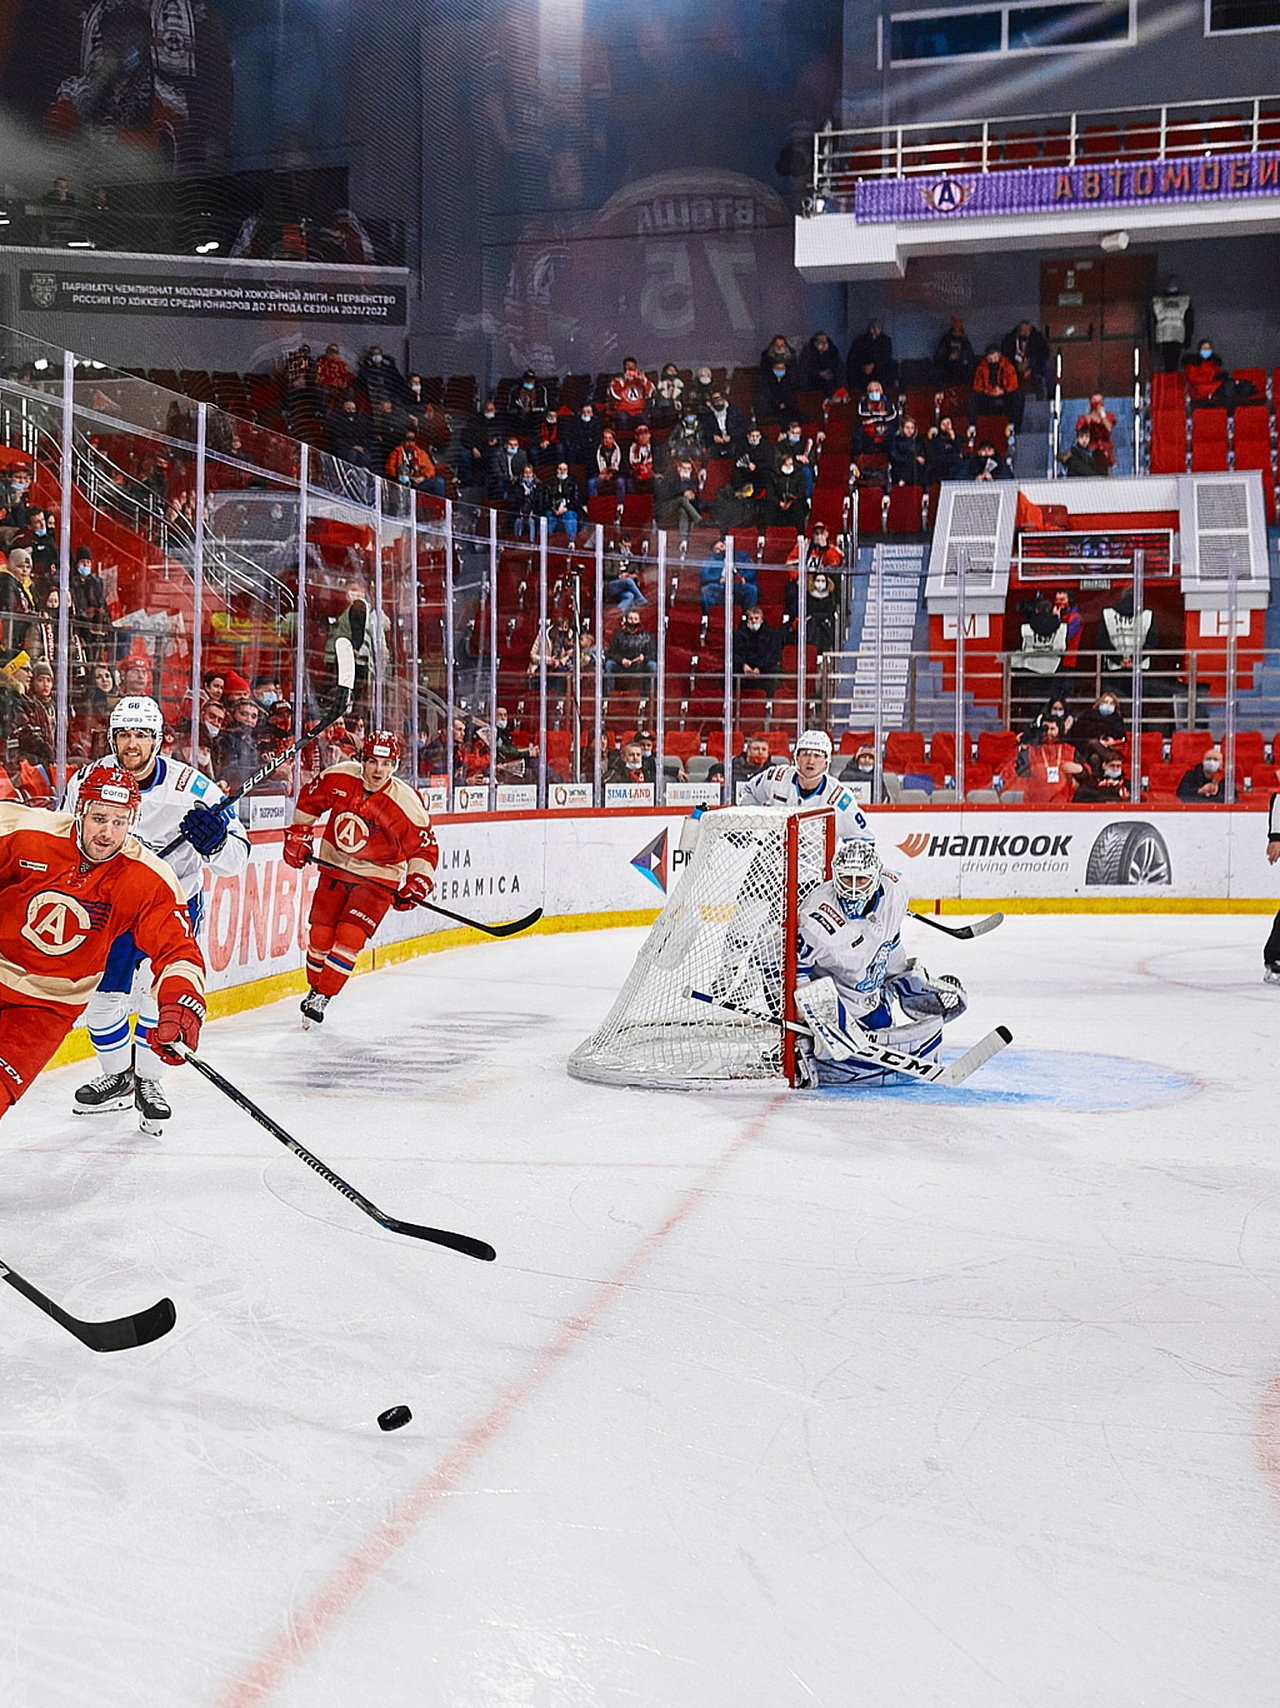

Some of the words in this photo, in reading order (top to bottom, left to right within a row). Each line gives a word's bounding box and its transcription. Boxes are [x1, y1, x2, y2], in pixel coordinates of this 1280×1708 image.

[72, 294, 111, 305] РОССИИ
[112, 296, 127, 305] ПО
[128, 297, 168, 307] ХОККЕЮ
[170, 298, 202, 309] СРЕДИ
[203, 300, 250, 311] ЮНИОРОВ
[251, 302, 266, 312] ДО
[267, 302, 276, 311] 21
[278, 303, 303, 313] ГОДА
[304, 304, 340, 315] СЕЗОНА
[341, 305, 388, 316] 2021/2022
[115, 284, 173, 295] ЧЕМПИОНАТ
[175, 286, 243, 299] МОЛОДЕЖНОЙ
[244, 289, 301, 301] ХОККЕЙНОЙ
[302, 292, 328, 302] ЛИГИ
[337, 294, 396, 305] ПЕРВЕНСТВО
[439, 849, 472, 870] LMA
[961, 860, 1008, 876] driving
[1011, 861, 1069, 873] emotion
[432, 875, 521, 902] CERAMICA
[201, 860, 319, 973] ONBE
